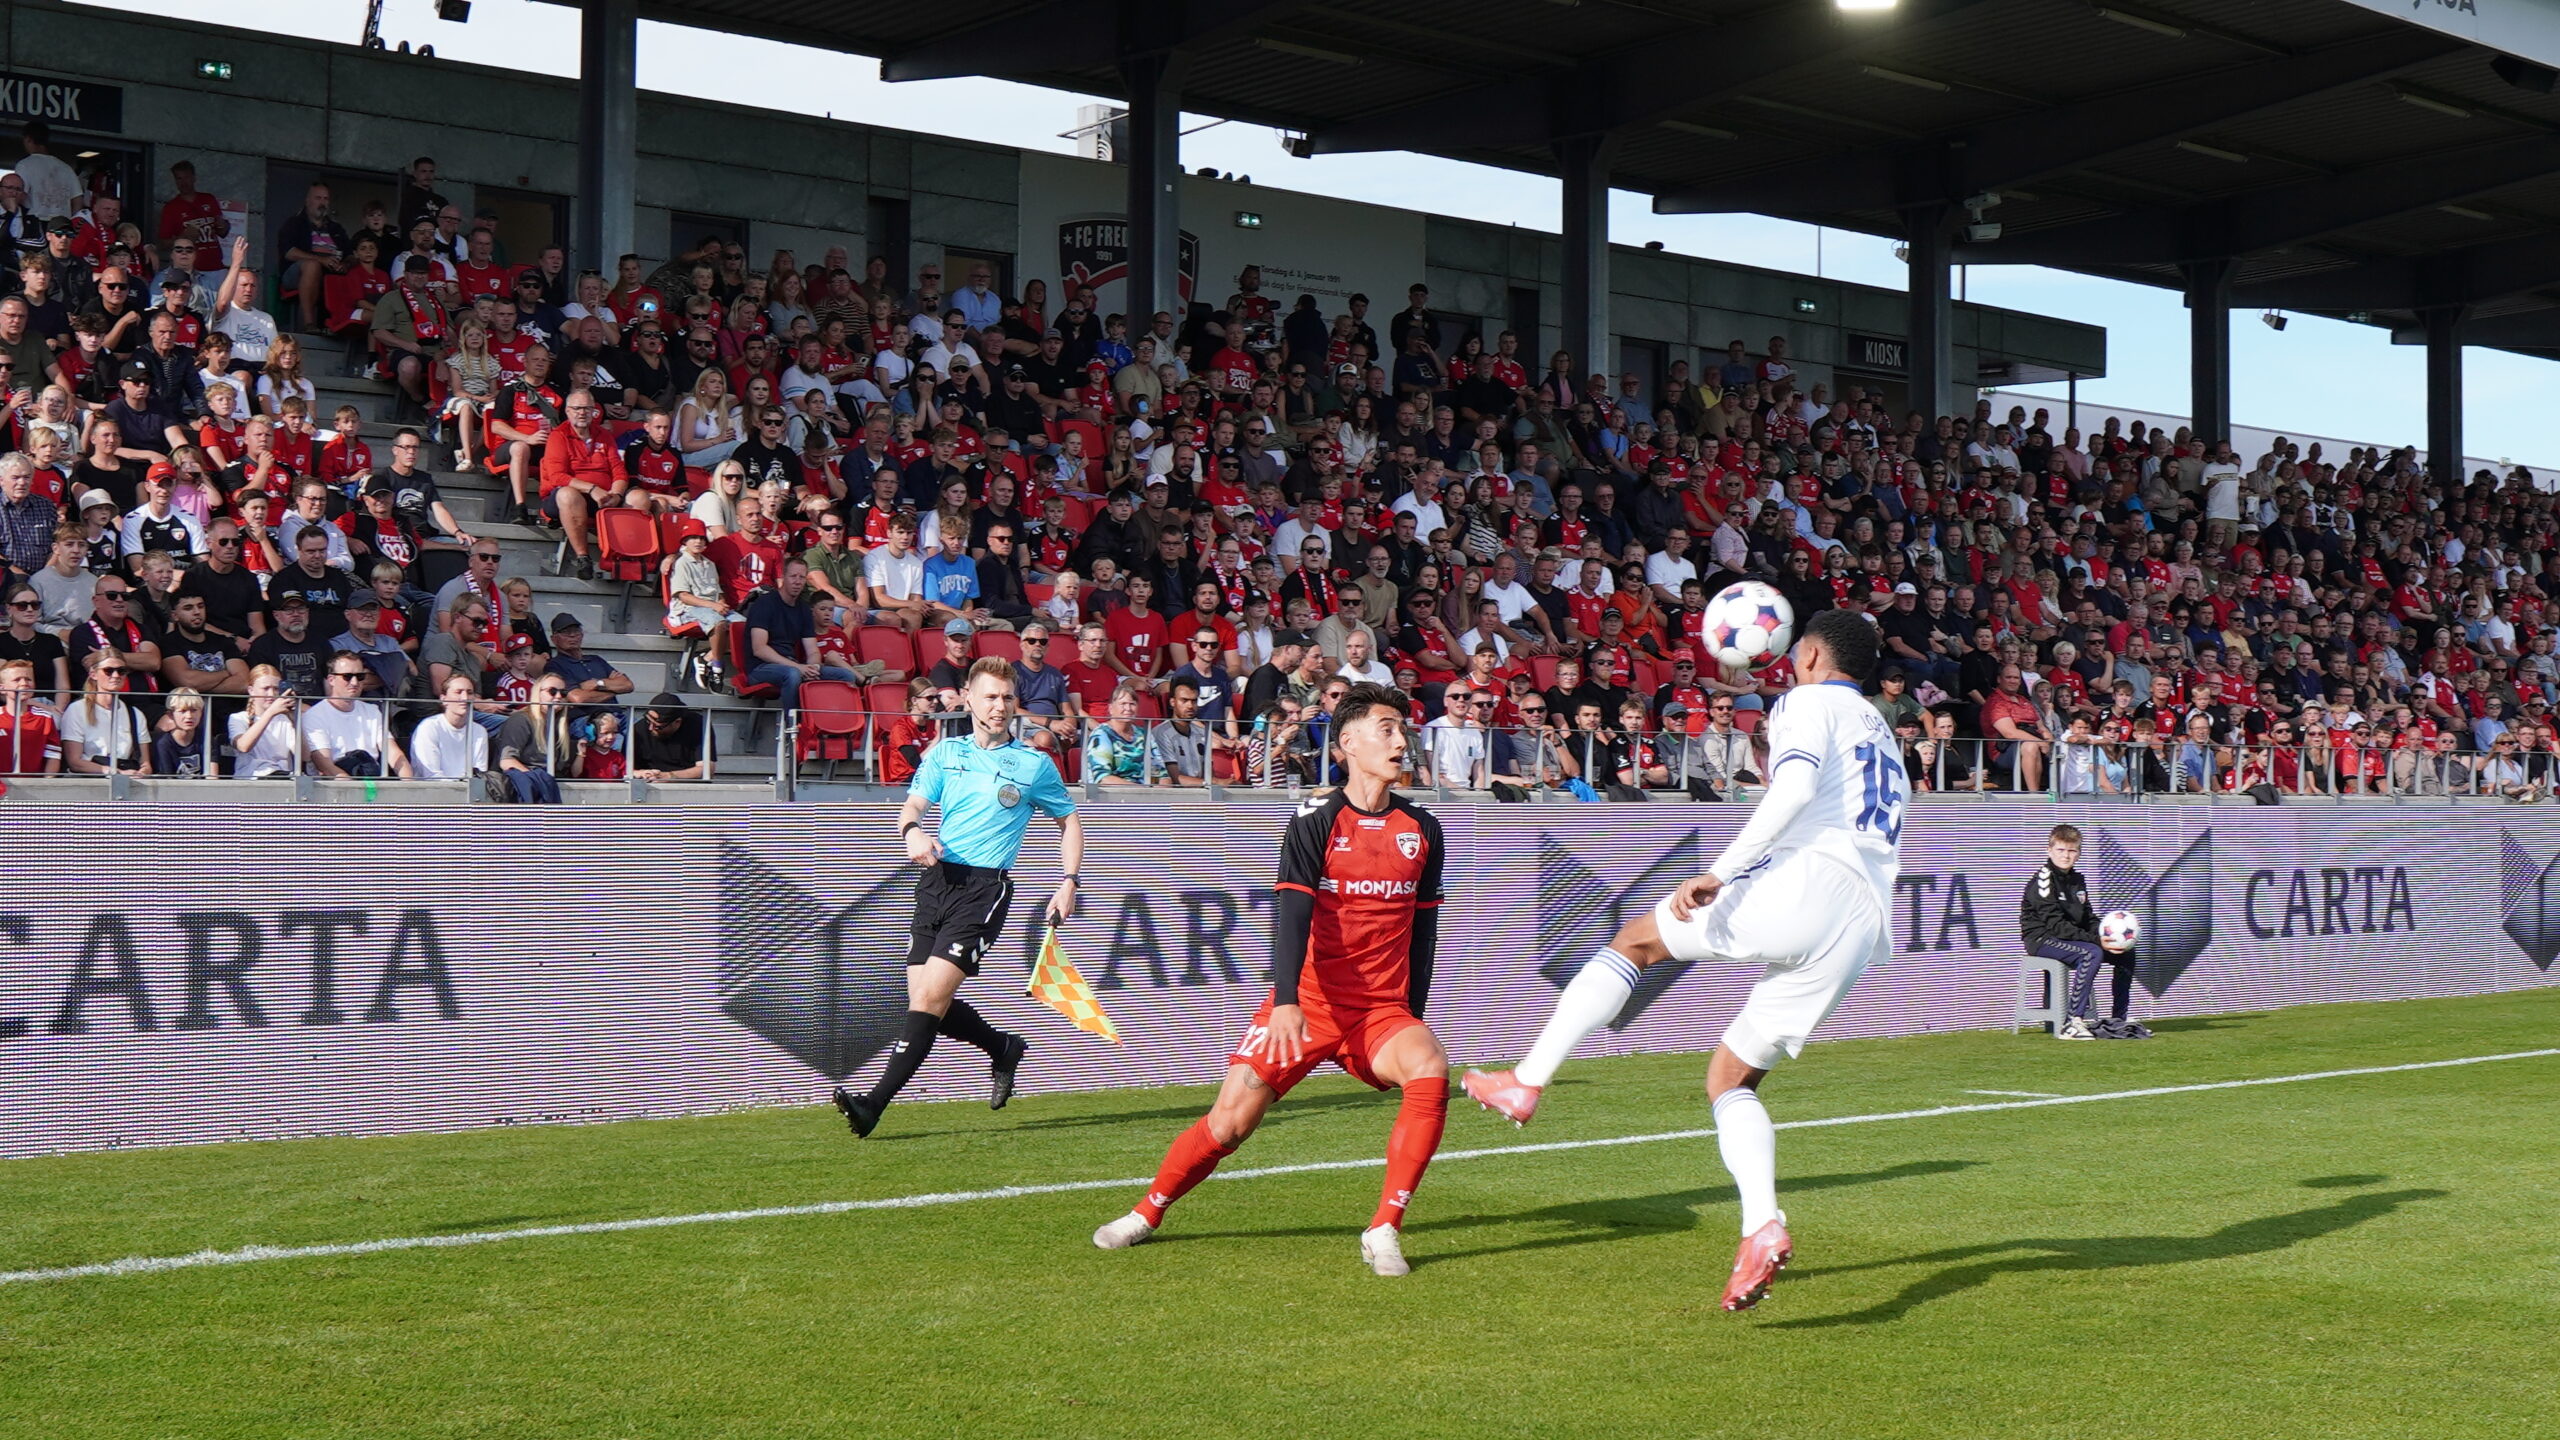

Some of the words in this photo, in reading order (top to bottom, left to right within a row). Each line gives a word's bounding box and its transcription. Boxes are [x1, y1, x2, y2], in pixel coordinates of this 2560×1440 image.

[0, 77, 82, 122] KIOSK
[1075, 225, 1093, 249] FC
[1865, 340, 1902, 367] KIOSK
[279, 652, 317, 670] PRIMUS
[510, 687, 527, 702] 19
[1346, 880, 1418, 898] MONJASA
[2245, 866, 2416, 939] CARTA
[1237, 1024, 1269, 1057] 12
